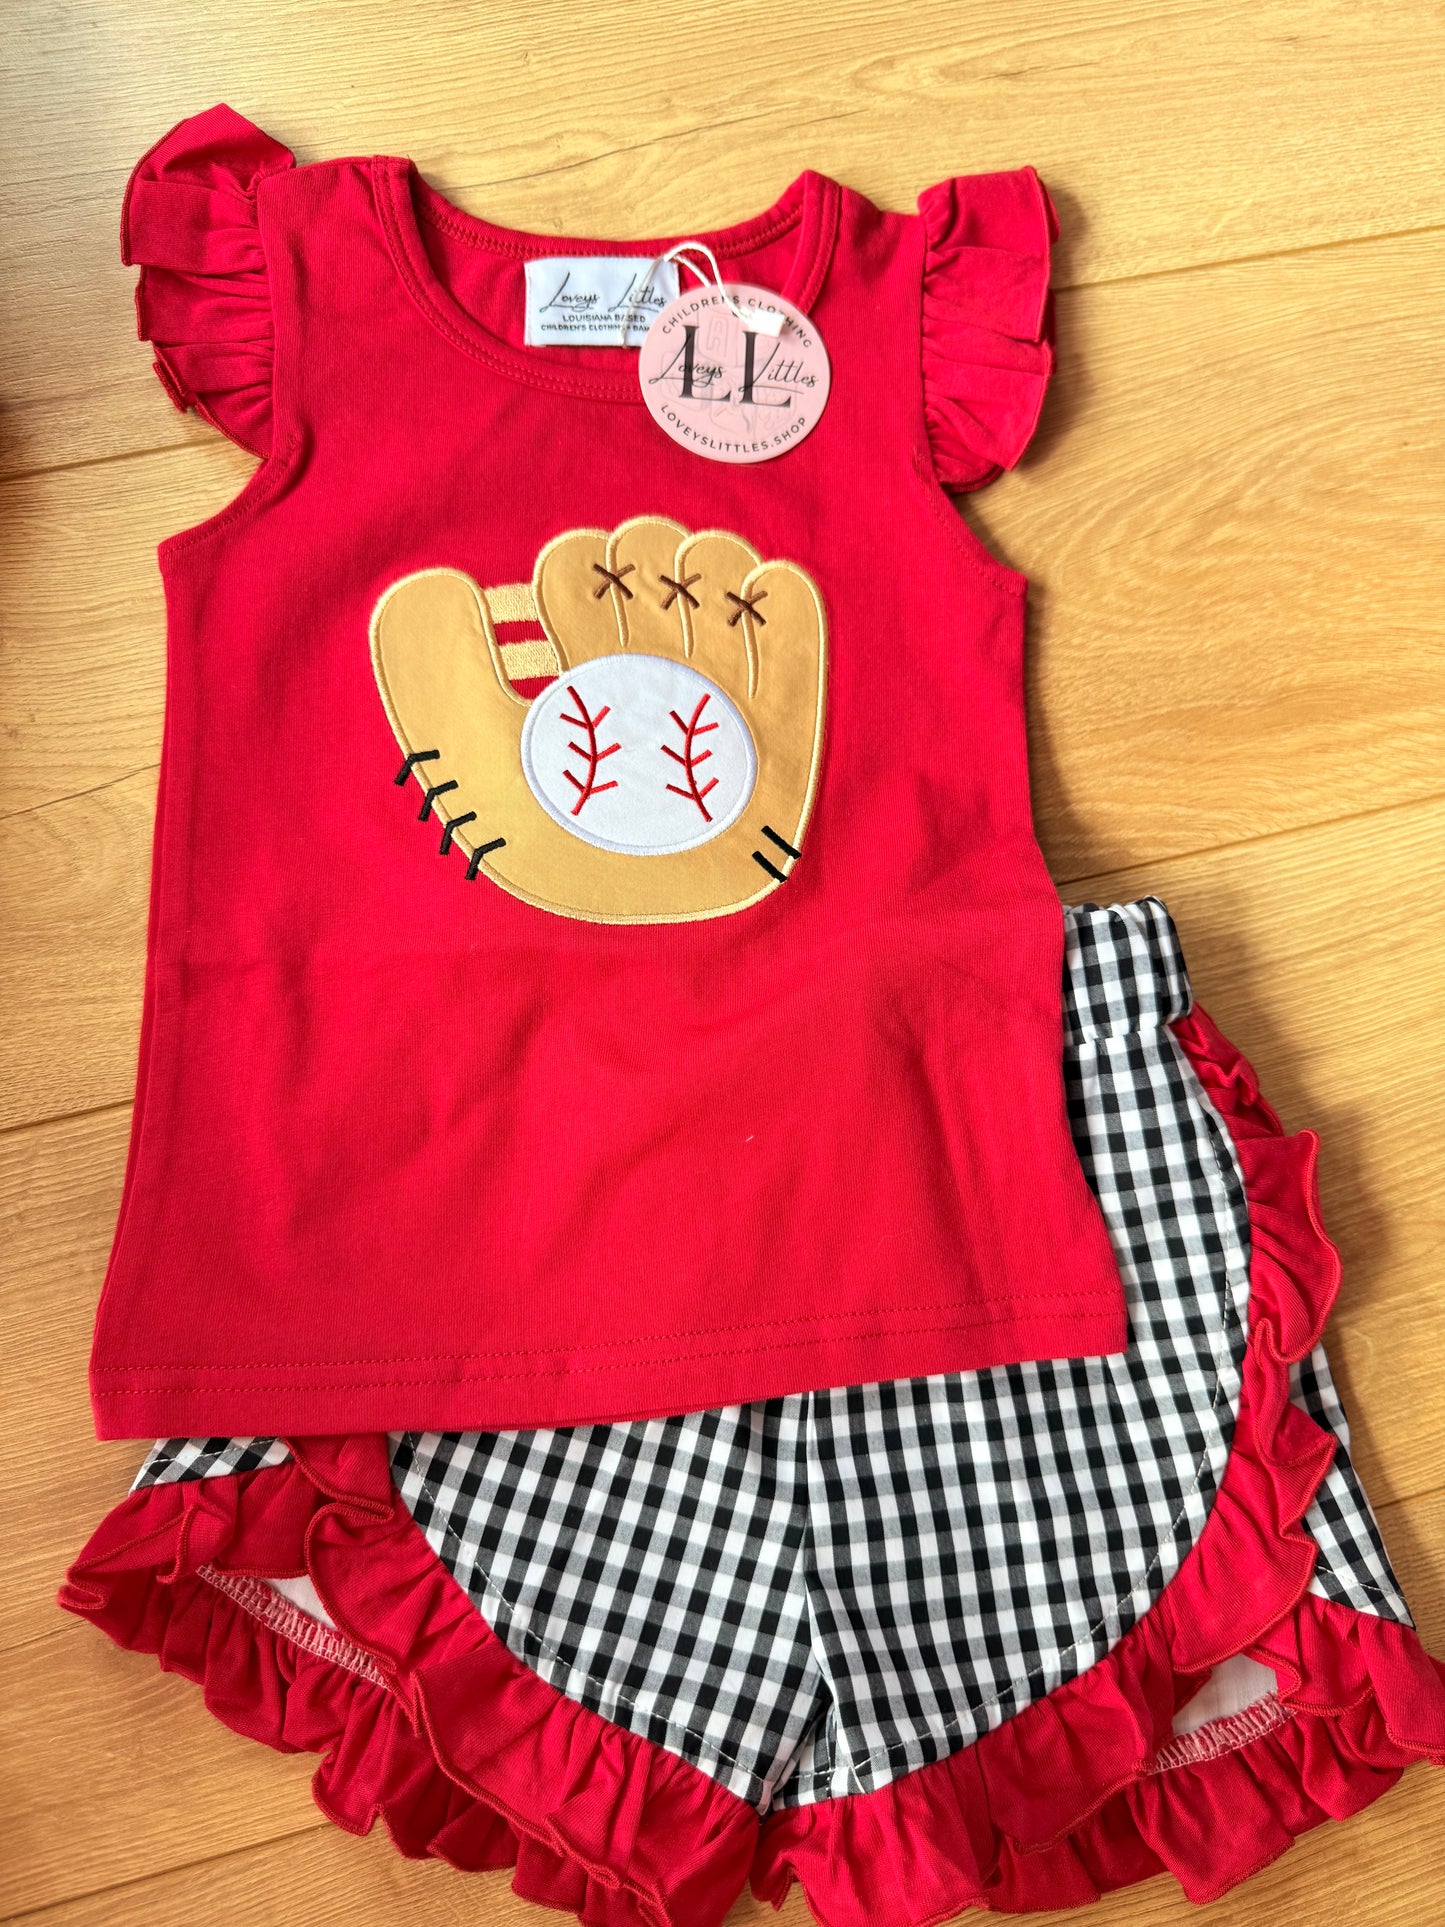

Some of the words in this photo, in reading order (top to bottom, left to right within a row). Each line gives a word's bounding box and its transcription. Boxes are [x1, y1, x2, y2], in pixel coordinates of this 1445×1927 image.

[539, 271, 600, 313] Loveys
[608, 272, 668, 313] Littles
[562, 314, 612, 322] LOUISIANA
[588, 324, 626, 332] CLOTHIN
[747, 297, 812, 348] CLOHING
[648, 334, 726, 389] Loveys
[738, 342, 820, 395] Littles
[660, 404, 806, 453] LOVEYSLITTLES.SHOP
